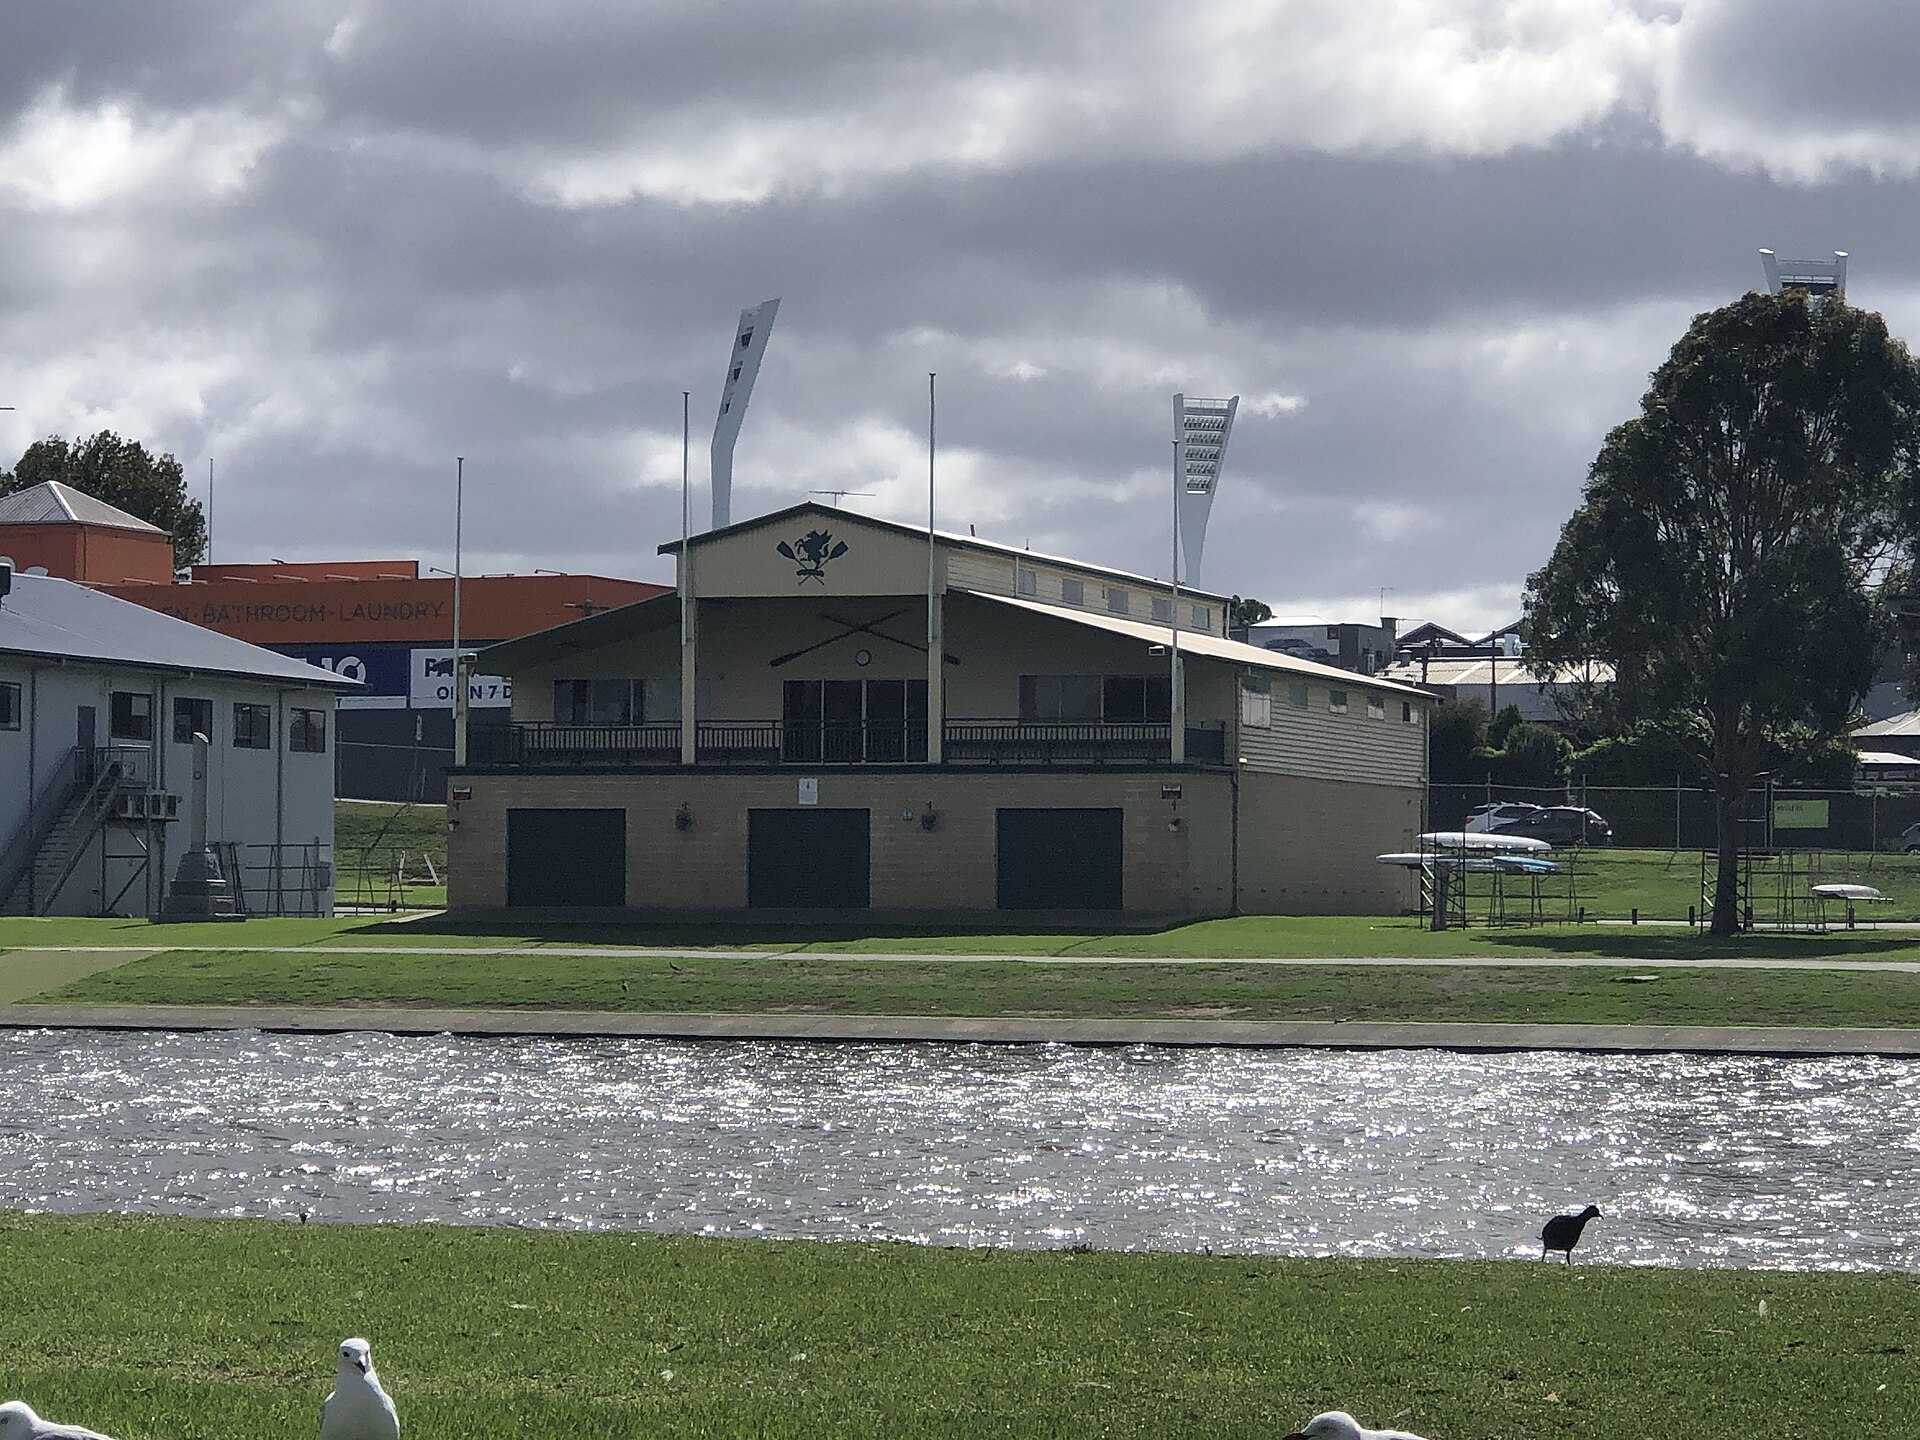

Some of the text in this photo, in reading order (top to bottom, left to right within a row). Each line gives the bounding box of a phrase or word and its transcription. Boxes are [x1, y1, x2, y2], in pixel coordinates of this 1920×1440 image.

[203, 603, 325, 622] BATHROOM
[340, 601, 444, 622] LAUNDRY
[436, 685, 483, 700] ON
